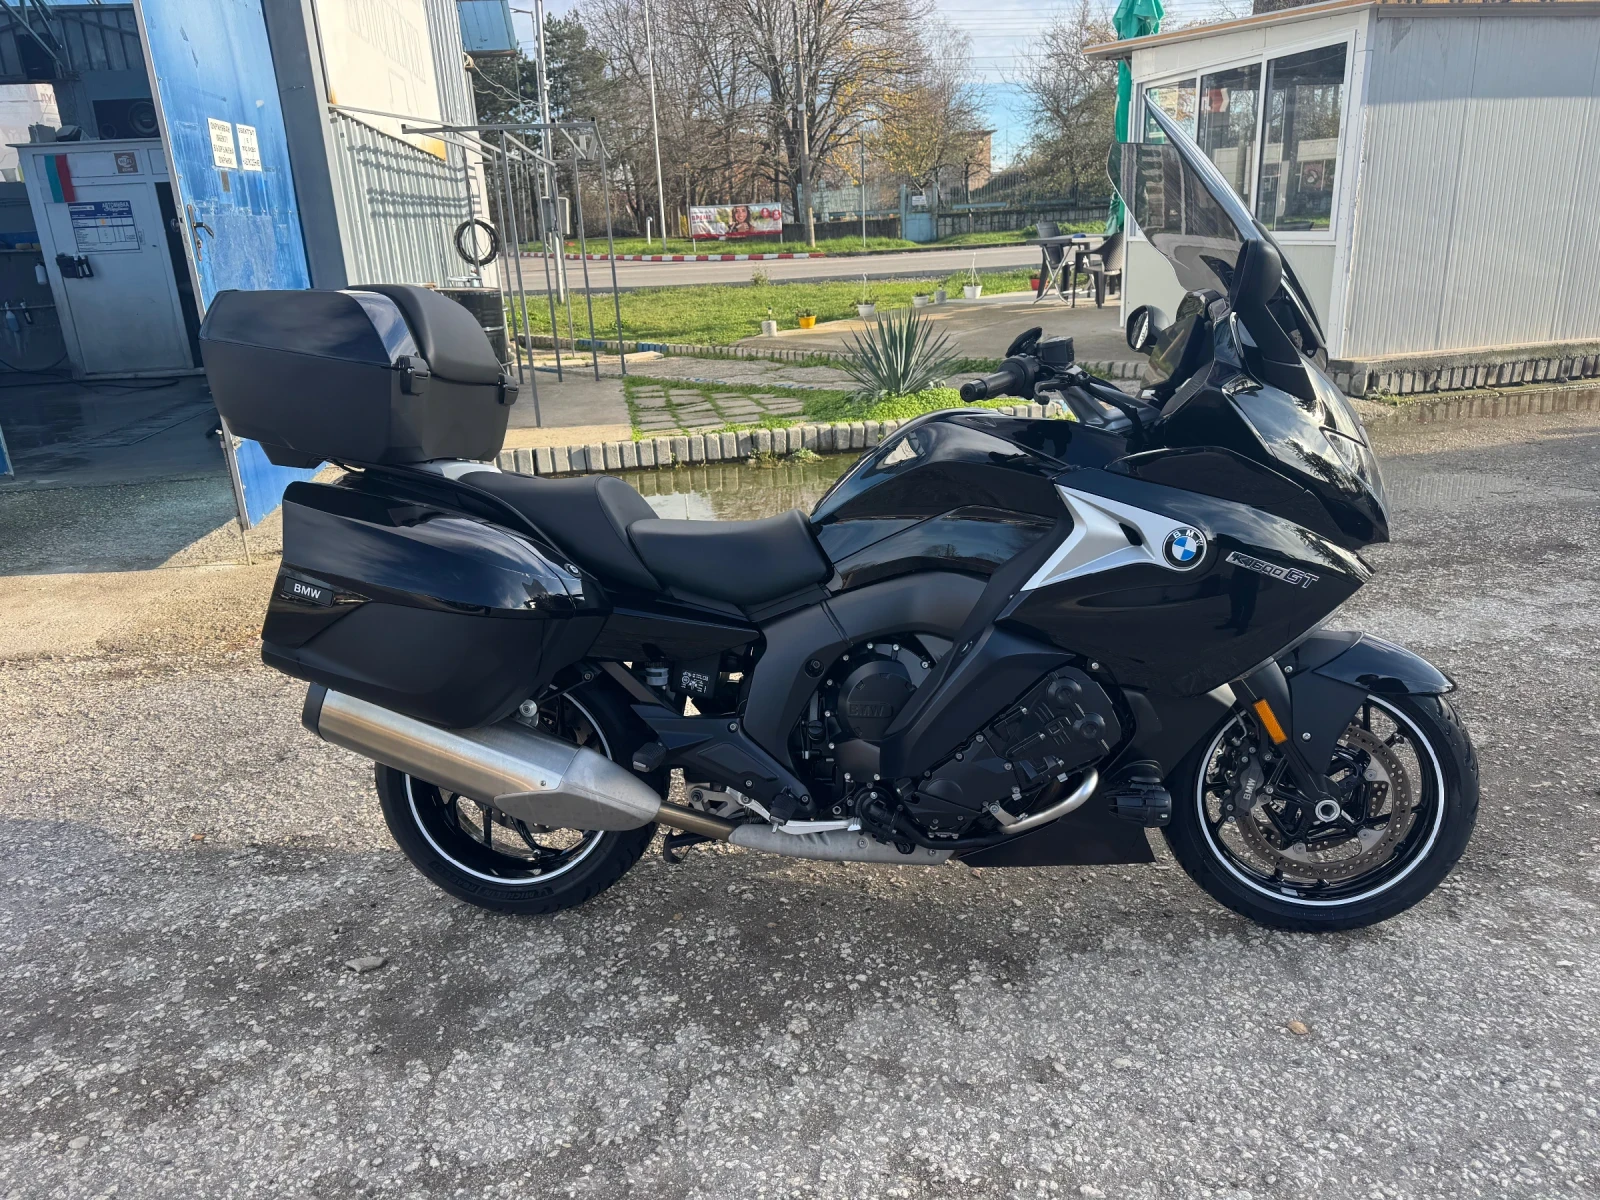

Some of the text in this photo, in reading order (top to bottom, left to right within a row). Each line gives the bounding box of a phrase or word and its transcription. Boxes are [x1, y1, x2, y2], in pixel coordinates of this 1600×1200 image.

[1227, 551, 1320, 589] K1600 GT
[293, 583, 321, 599] BMW
[850, 704, 885, 717] BMW
[1243, 778, 1256, 800] BMW
